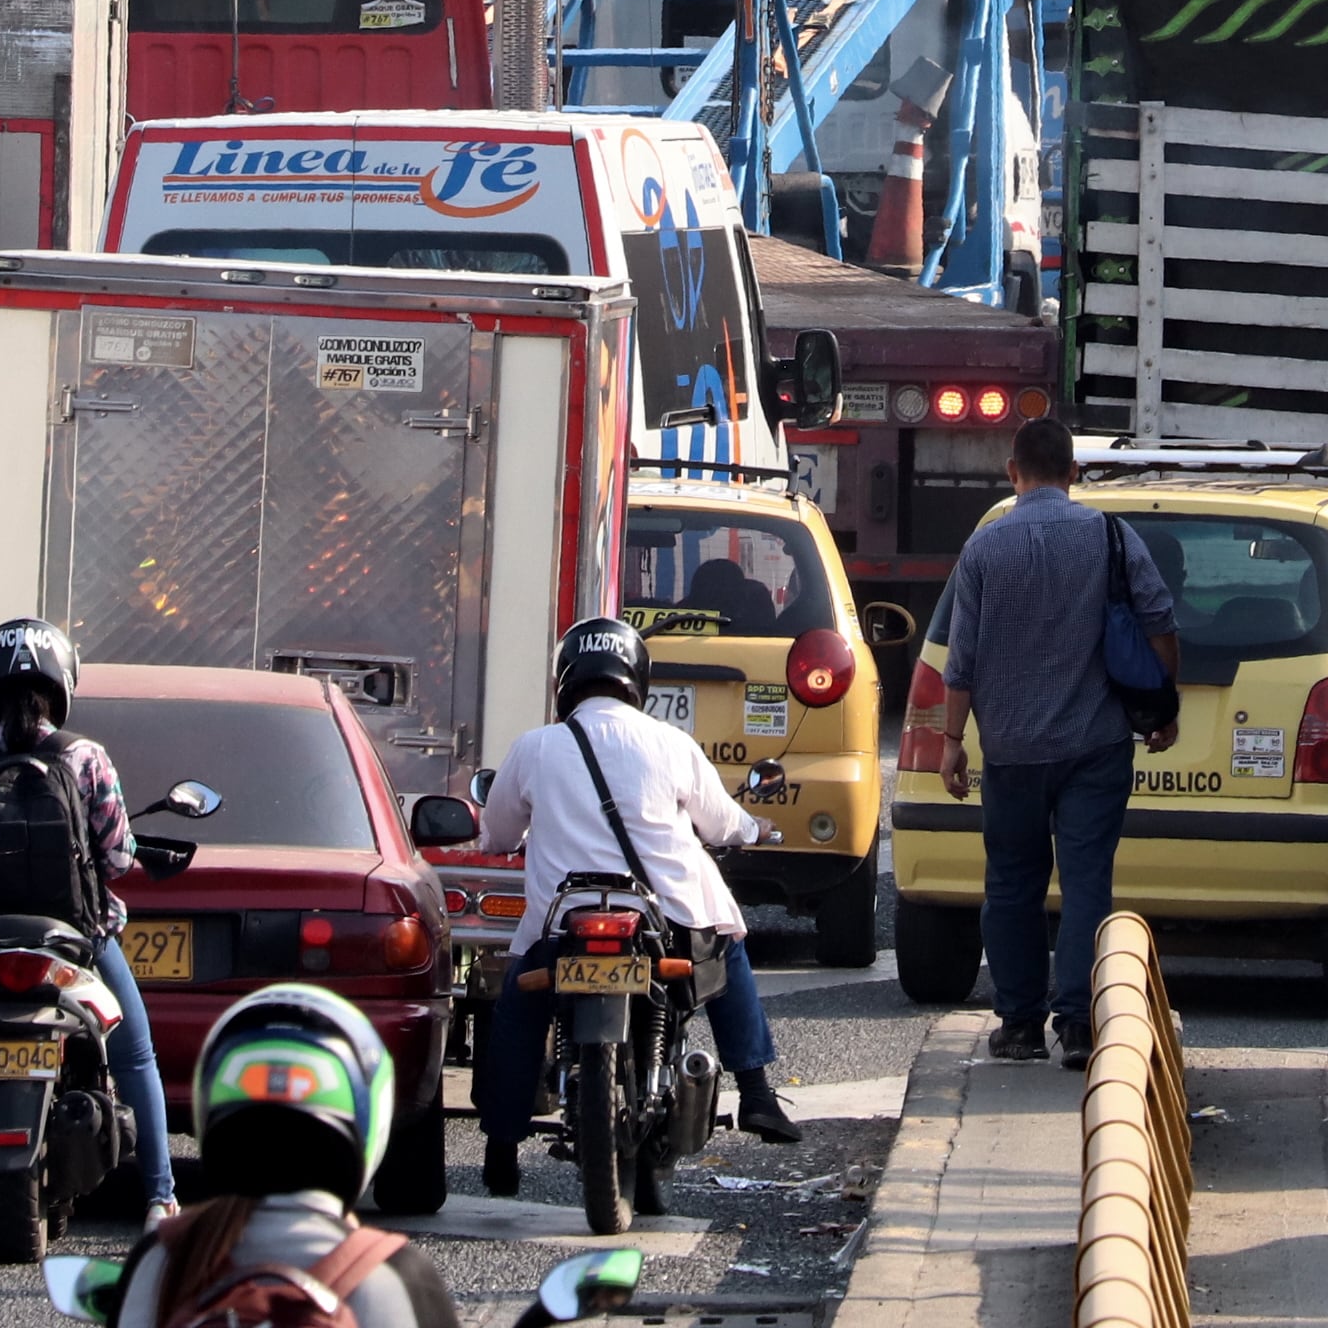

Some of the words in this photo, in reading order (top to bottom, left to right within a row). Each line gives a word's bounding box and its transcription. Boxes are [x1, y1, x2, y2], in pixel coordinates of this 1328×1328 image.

[373, 162, 398, 176] de
[401, 162, 421, 176] la
[163, 193, 178, 204] TE
[181, 192, 243, 204] LLEVAMOS
[247, 192, 256, 203] A
[262, 192, 317, 203] CUMPLIR
[320, 192, 344, 203] TUS
[353, 192, 420, 204] PROMESAS
[320, 339, 357, 351] ¿COMO
[358, 339, 422, 353] CONDUZCO?
[327, 353, 374, 365] MARQUE
[375, 355, 412, 366] GRATIS
[323, 368, 360, 382] #767
[367, 366, 406, 377] Opción
[408, 367, 417, 377] 3
[578, 632, 625, 655] XAZ67C
[1135, 771, 1221, 793] PUBLICO
